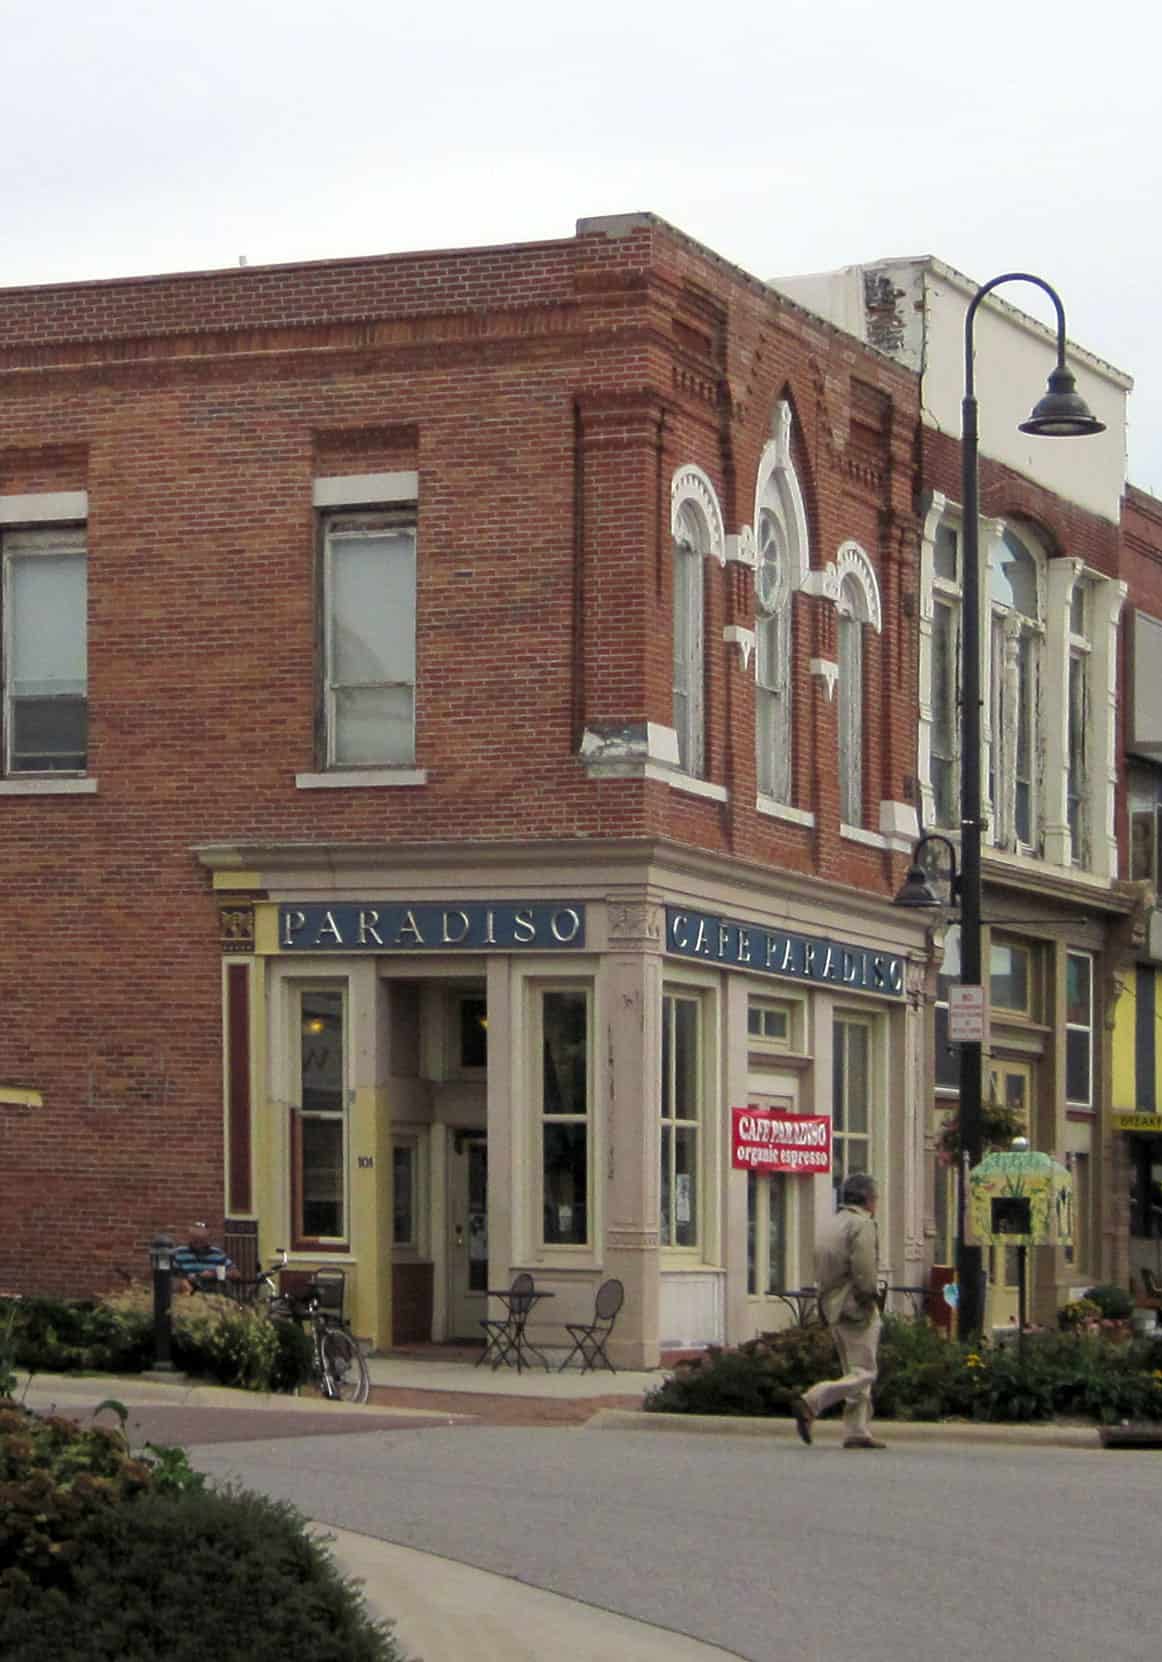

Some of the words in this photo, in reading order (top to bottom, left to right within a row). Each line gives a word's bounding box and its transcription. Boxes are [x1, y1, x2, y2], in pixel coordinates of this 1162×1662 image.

[283, 907, 580, 946] PARADISO
[672, 914, 752, 962] CAFE
[764, 931, 903, 992] PARADISO
[738, 1115, 770, 1143] CAFE
[769, 1119, 827, 1147] PARADISO
[736, 1143, 780, 1167] organic
[780, 1148, 829, 1169] espresso
